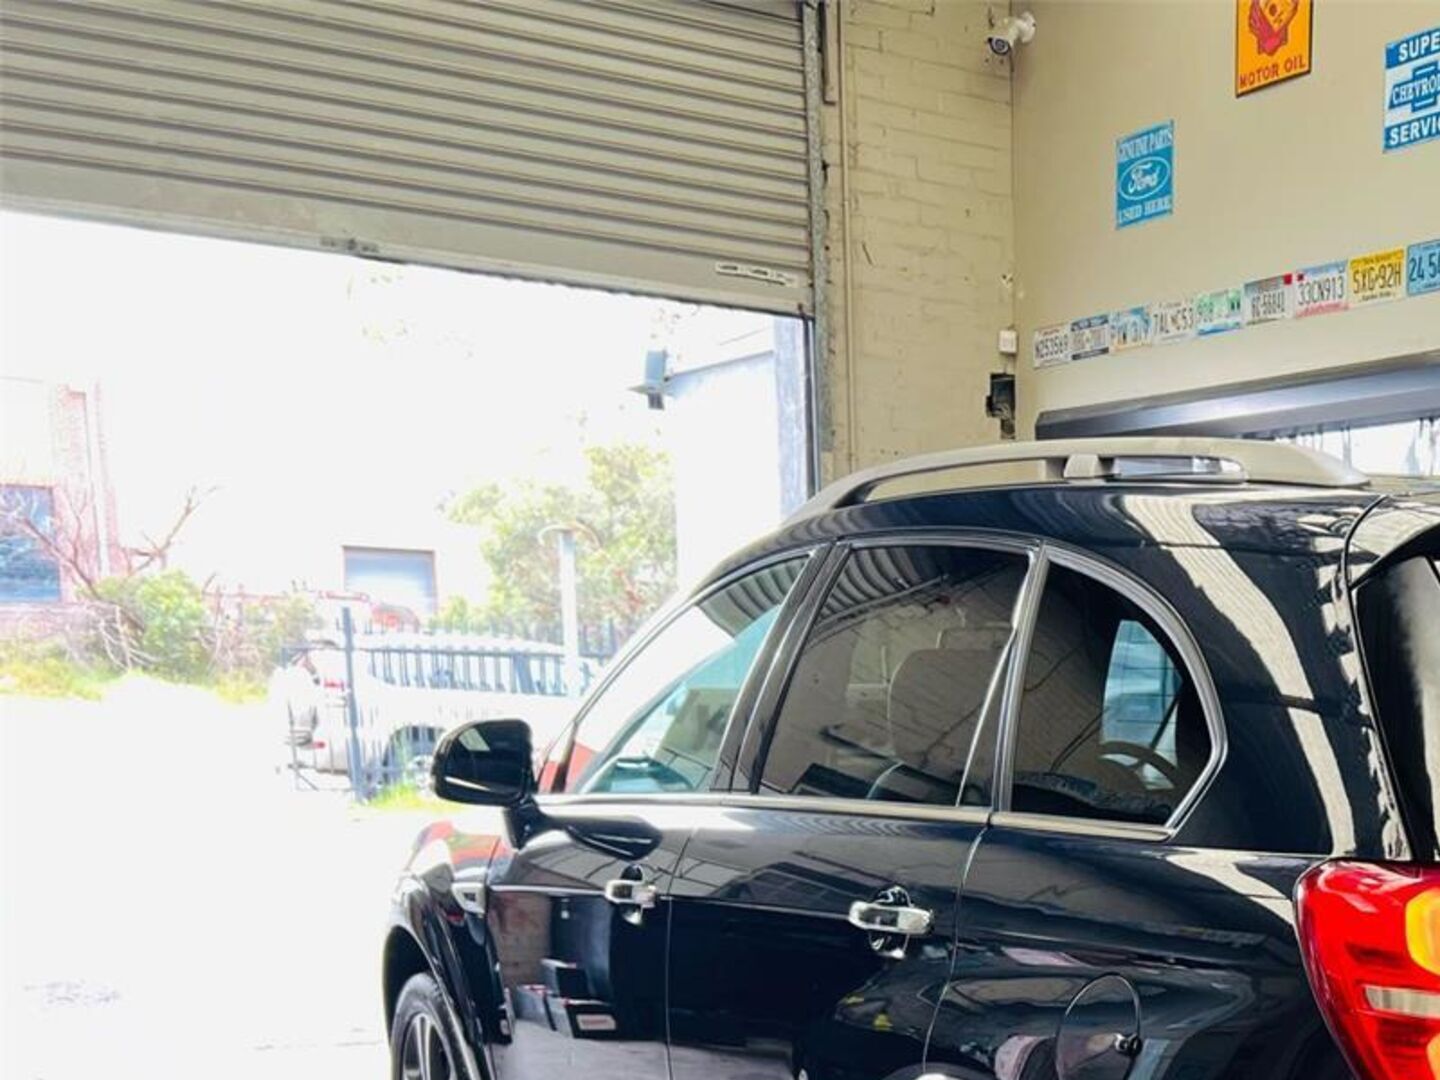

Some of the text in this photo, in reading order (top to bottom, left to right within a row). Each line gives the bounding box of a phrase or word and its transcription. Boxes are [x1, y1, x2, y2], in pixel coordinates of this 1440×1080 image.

[1239, 55, 1306, 89] MOTOR OIL
[1128, 162, 1161, 194] Ford
